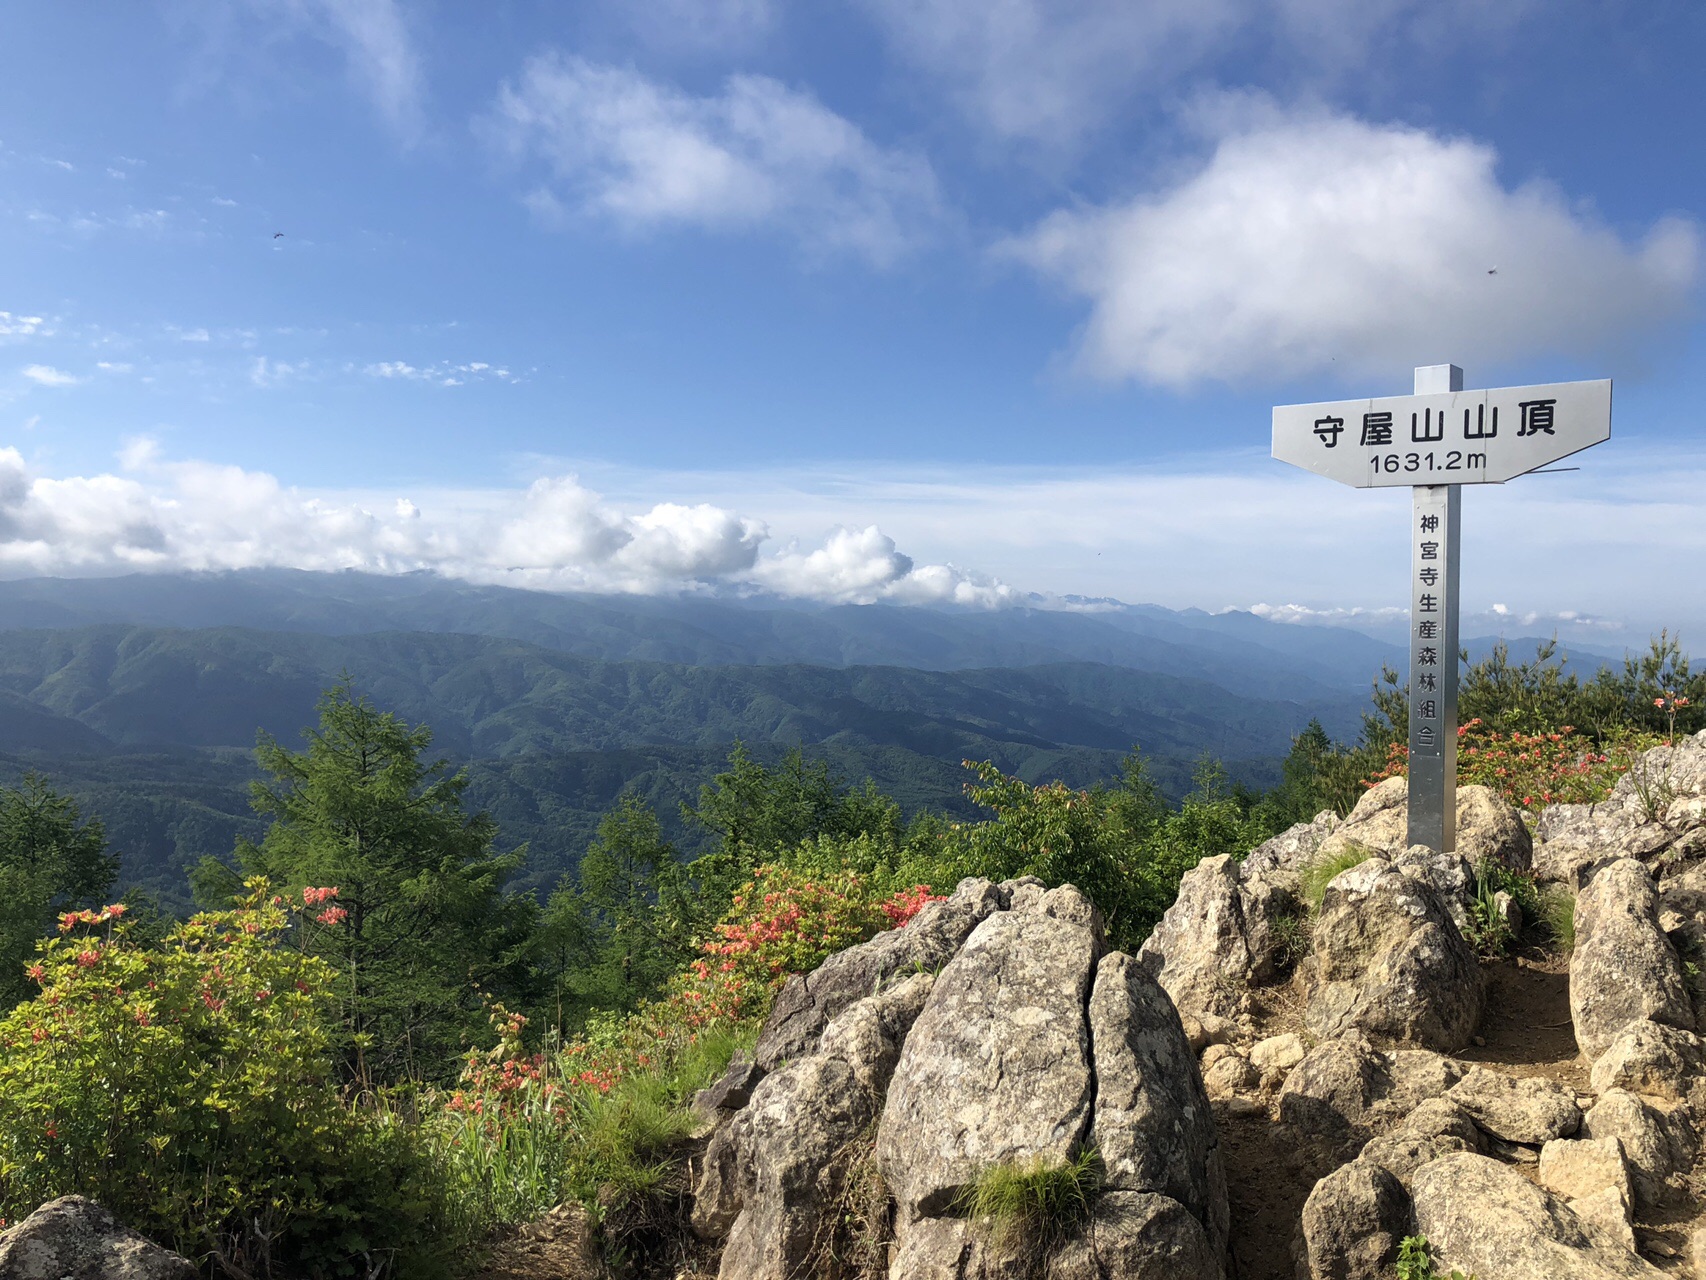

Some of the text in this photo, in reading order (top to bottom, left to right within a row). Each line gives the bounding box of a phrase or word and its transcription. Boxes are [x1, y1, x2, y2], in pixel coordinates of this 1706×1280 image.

[1313, 399, 1557, 448] 守屋山山頂
[1370, 451, 1487, 474] 1631.2m
[1417, 514, 1439, 747] 神宮寺生産森林組合
